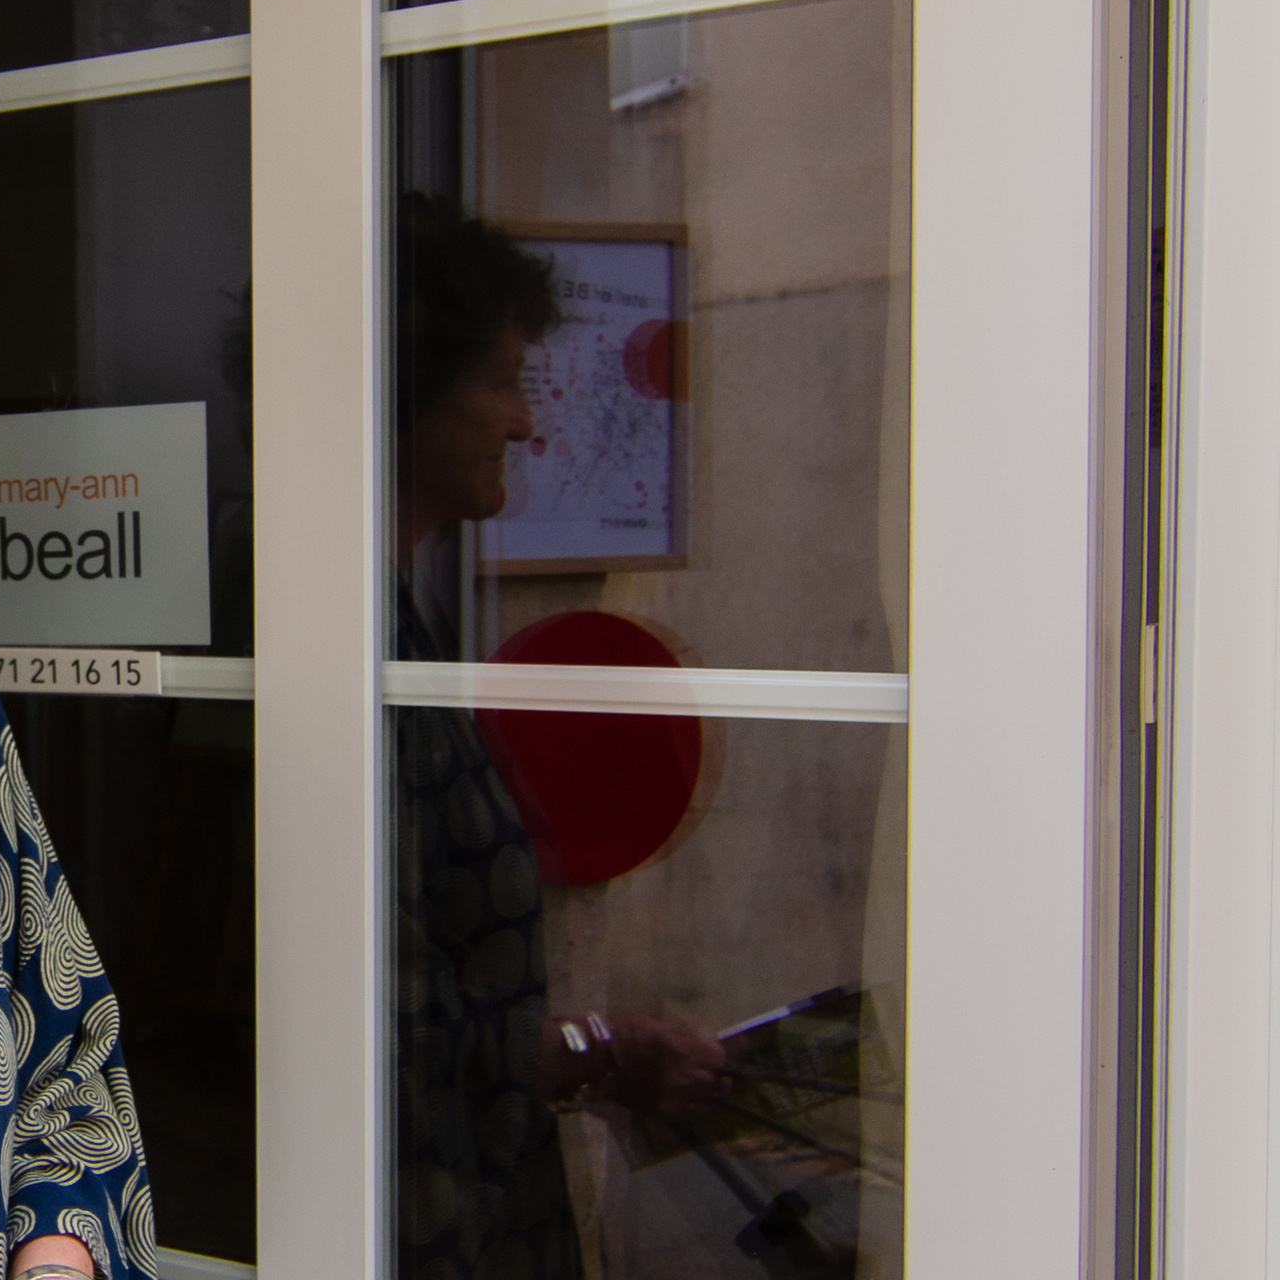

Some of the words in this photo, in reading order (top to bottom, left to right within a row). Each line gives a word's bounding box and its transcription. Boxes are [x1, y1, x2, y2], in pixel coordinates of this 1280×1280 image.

[30, 657, 58, 684] 21
[70, 659, 102, 686] 16
[111, 659, 142, 687] 15
